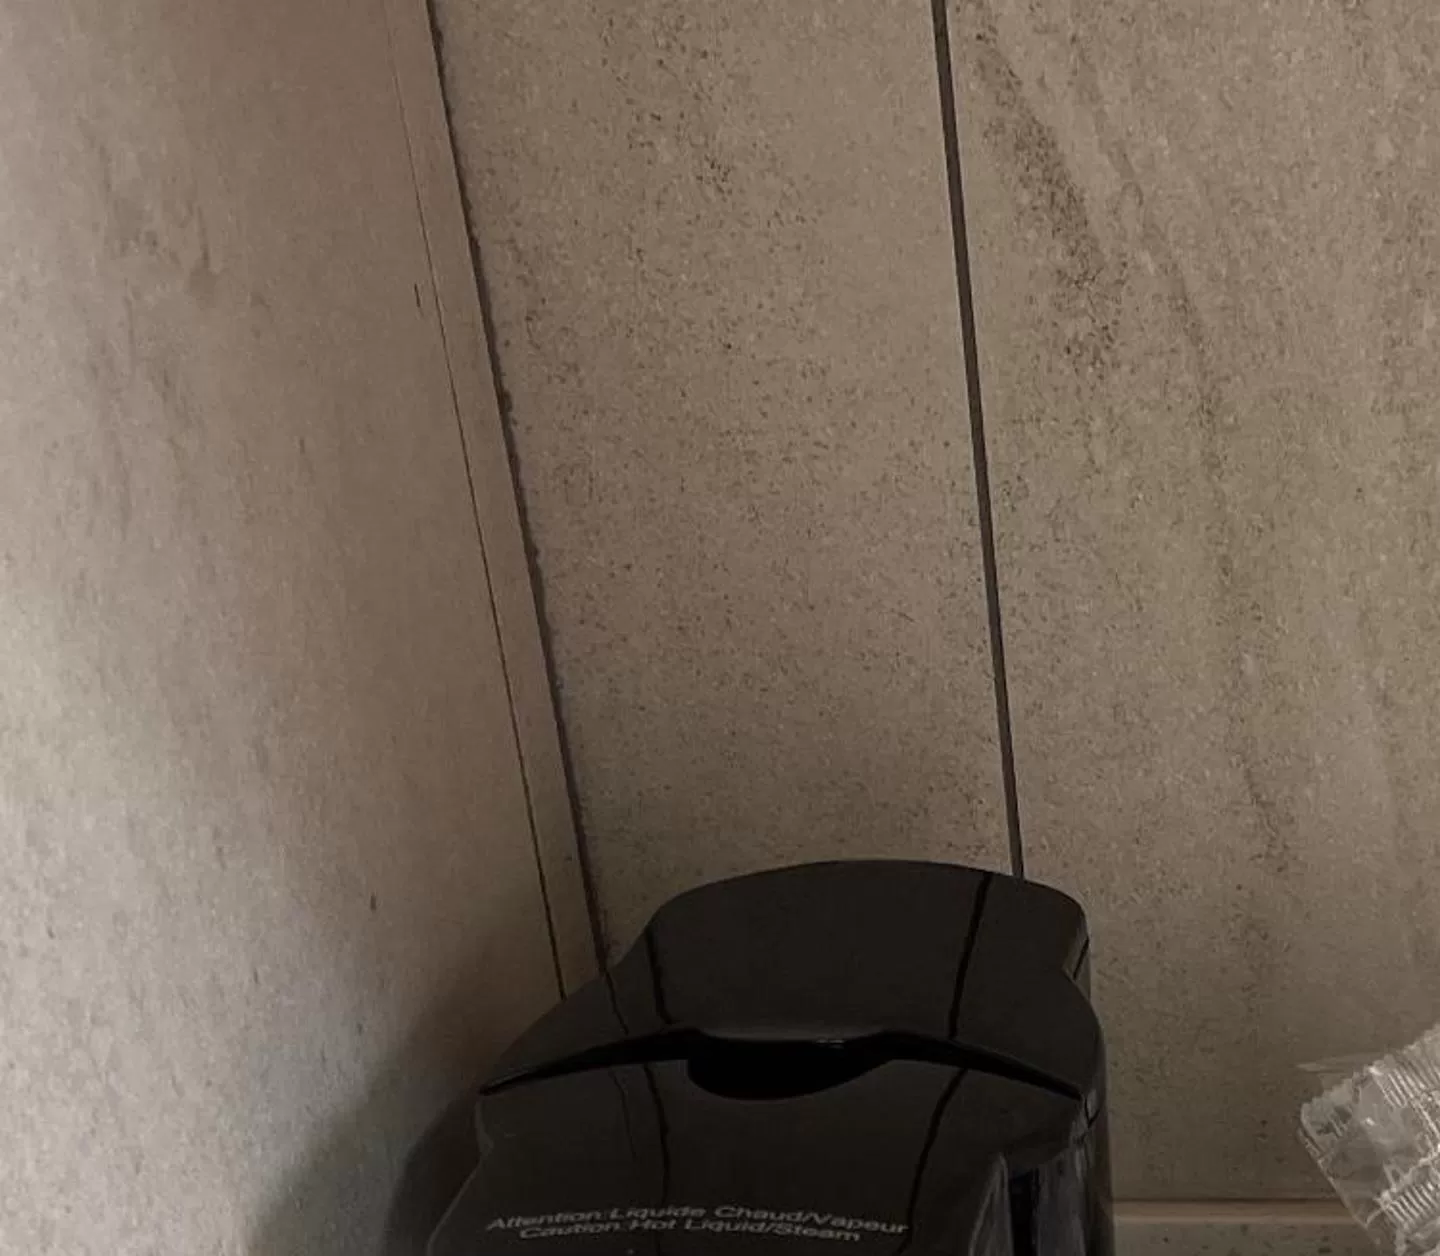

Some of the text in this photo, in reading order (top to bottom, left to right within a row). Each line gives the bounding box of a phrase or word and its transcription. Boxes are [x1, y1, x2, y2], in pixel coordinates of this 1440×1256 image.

[486, 1209, 601, 1231] Attention
[609, 1206, 706, 1220] Liquide
[520, 1217, 860, 1242] Caution Hot Liquid/Steam
